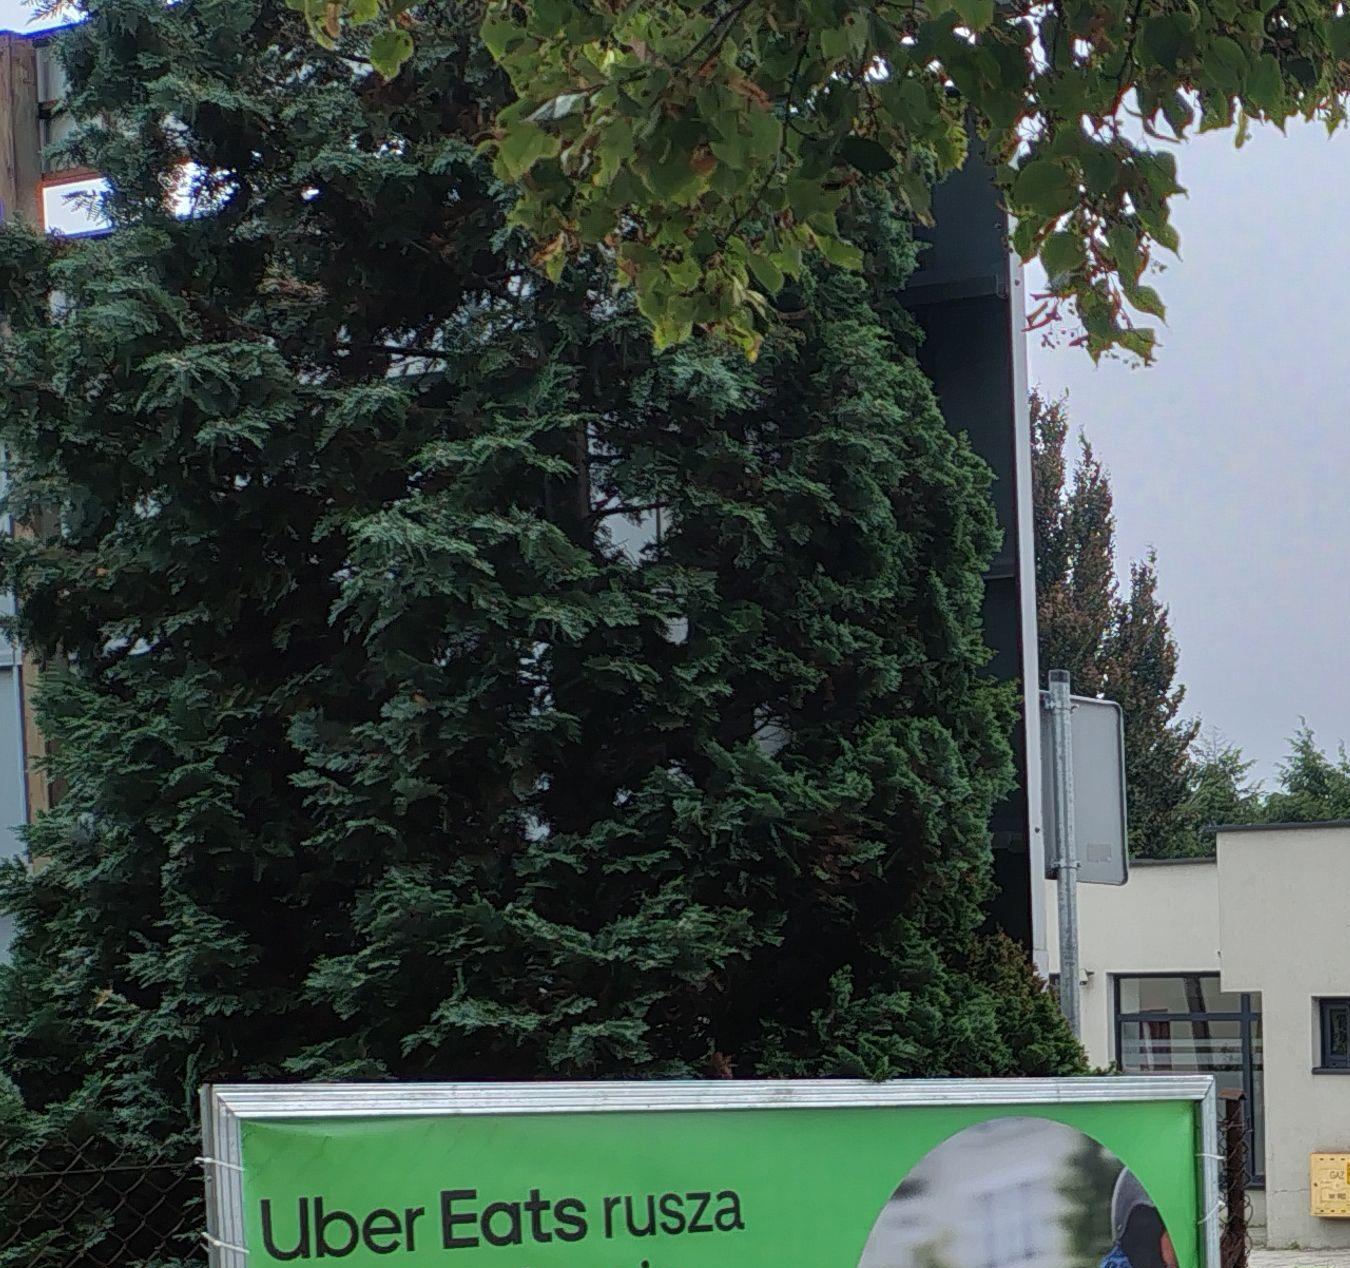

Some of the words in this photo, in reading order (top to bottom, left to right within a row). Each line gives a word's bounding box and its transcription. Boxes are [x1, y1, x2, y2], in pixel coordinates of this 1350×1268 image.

[260, 1196, 424, 1260] Uber
[440, 1188, 588, 1250] Eats
[603, 1188, 745, 1240] rusza
